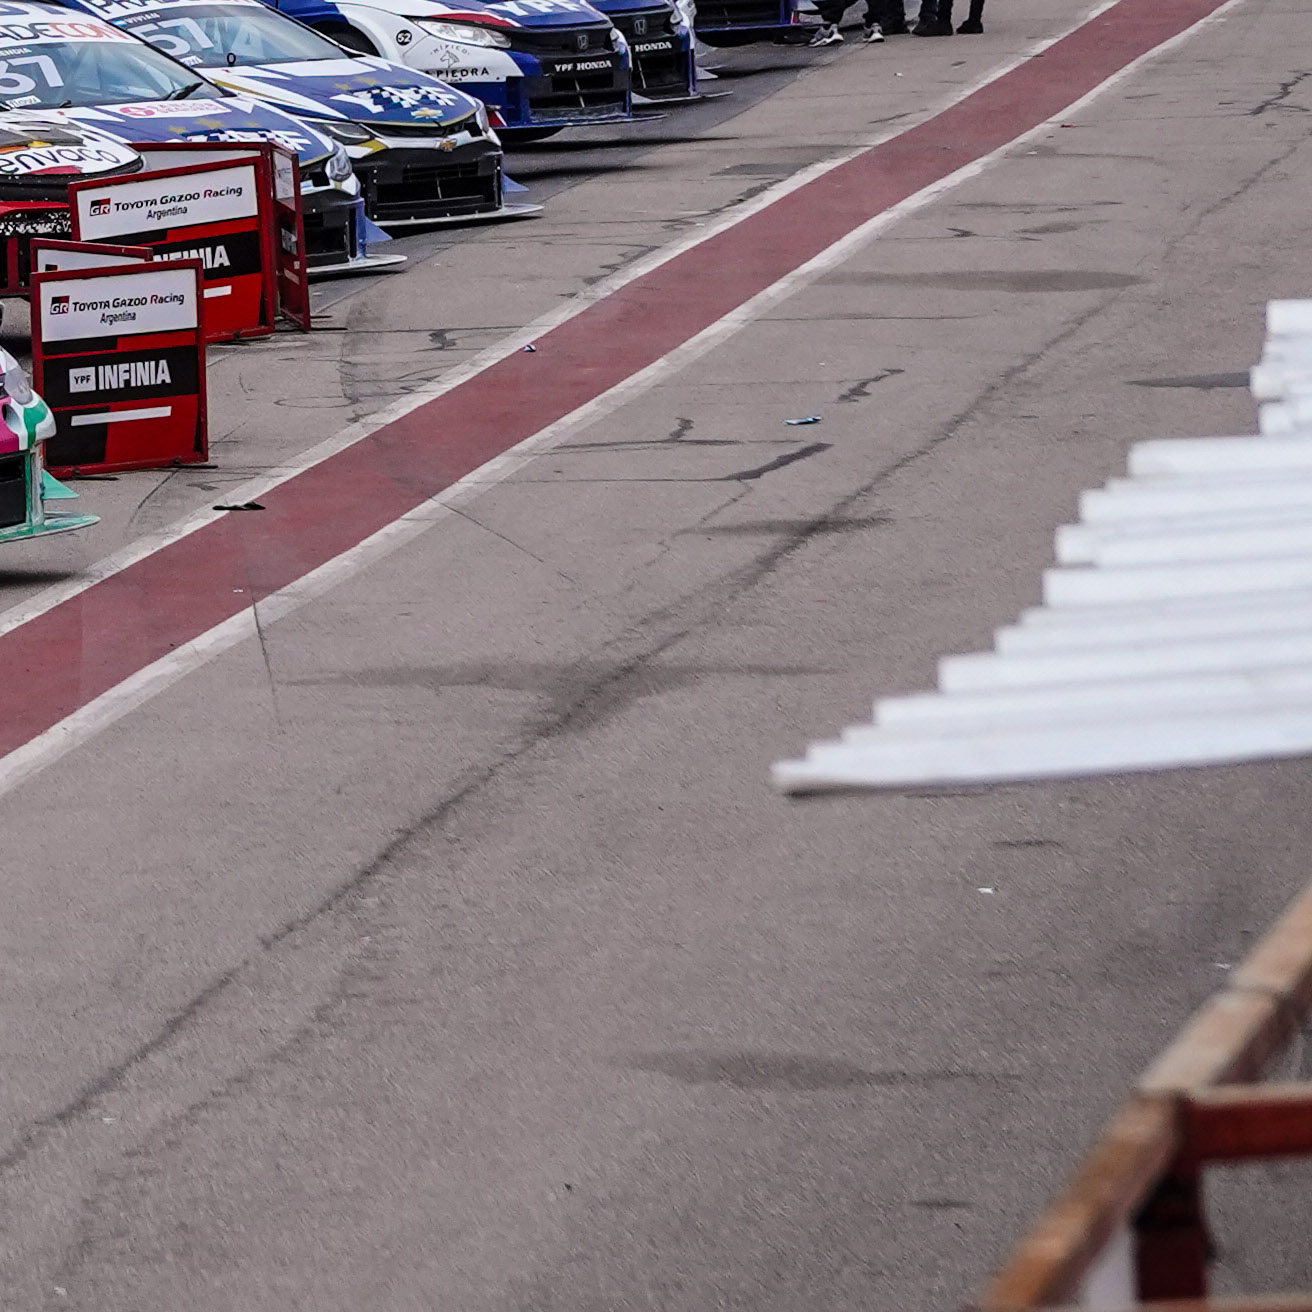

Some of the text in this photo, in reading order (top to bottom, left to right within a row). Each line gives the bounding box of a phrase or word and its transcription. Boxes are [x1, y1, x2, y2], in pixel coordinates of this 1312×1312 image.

[125, 18, 215, 57] 57
[397, 31, 413, 45] 52
[634, 41, 673, 53] HONDA
[435, 66, 491, 78] PIEDRA
[554, 60, 613, 73] YPF HONDA
[90, 186, 243, 217] GR TOYOTA GAZOO Racing
[146, 205, 188, 220] Argentina
[50, 293, 185, 315] GR TOYOTA GAZOO Racing
[100, 310, 136, 326] Argentina
[73, 359, 172, 390] YPF INFINIA
